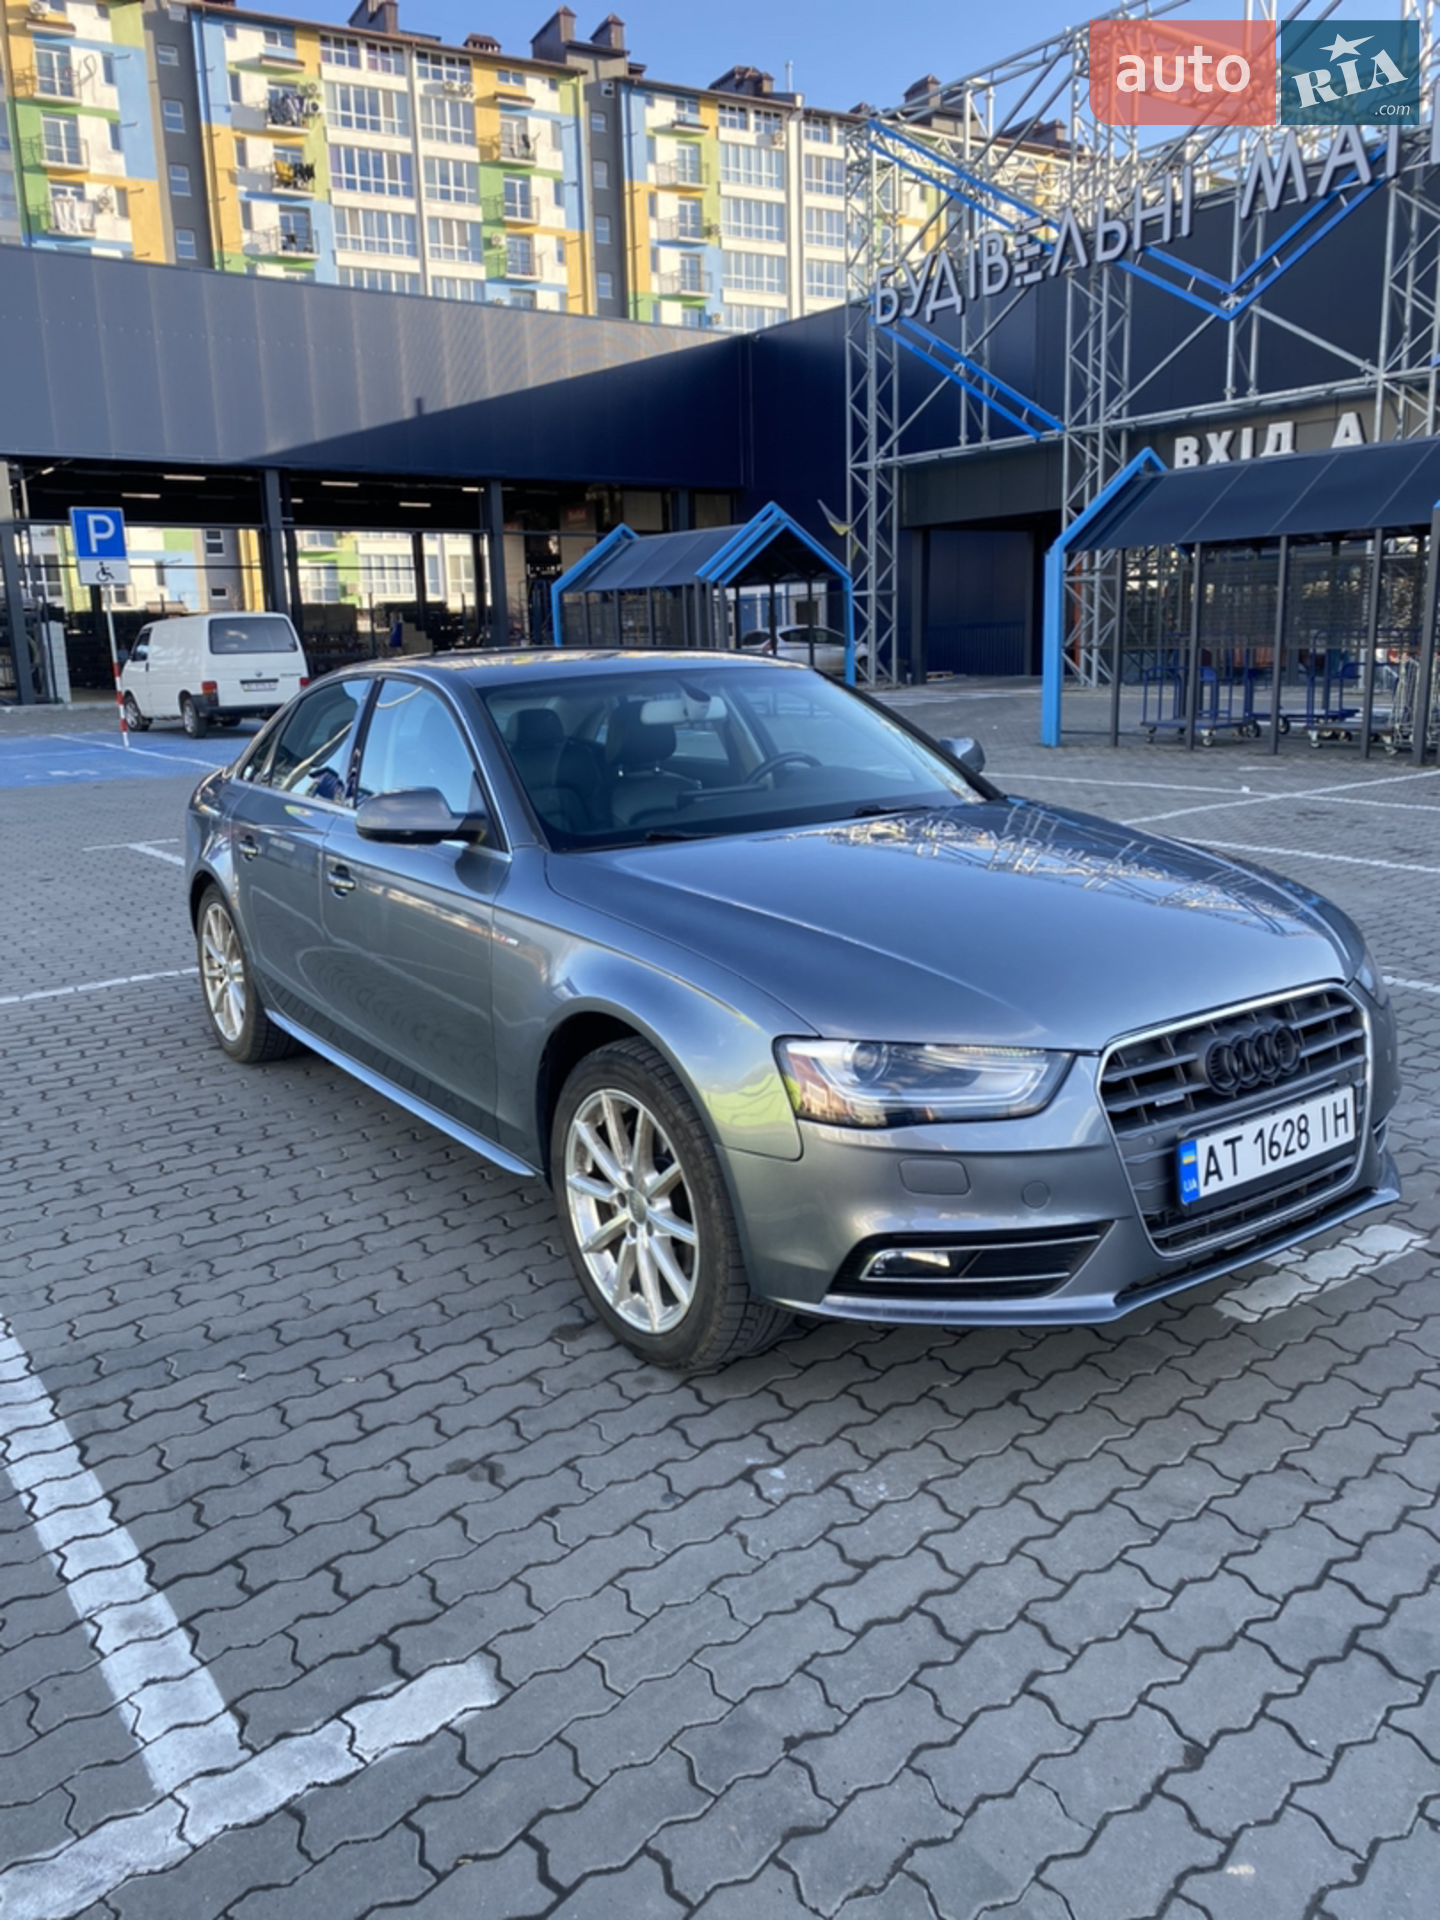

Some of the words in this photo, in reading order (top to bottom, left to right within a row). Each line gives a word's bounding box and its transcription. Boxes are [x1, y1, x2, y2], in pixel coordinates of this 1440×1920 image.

[875, 163, 1193, 325] БУДІВЕЛЬНІ
[1174, 421, 1296, 469] ВХІД
[1331, 412, 1365, 448] А
[87, 514, 115, 553] P
[1203, 1136, 1243, 1187] AT
[1254, 1113, 1310, 1166] 1628
[1321, 1097, 1349, 1144] IH
